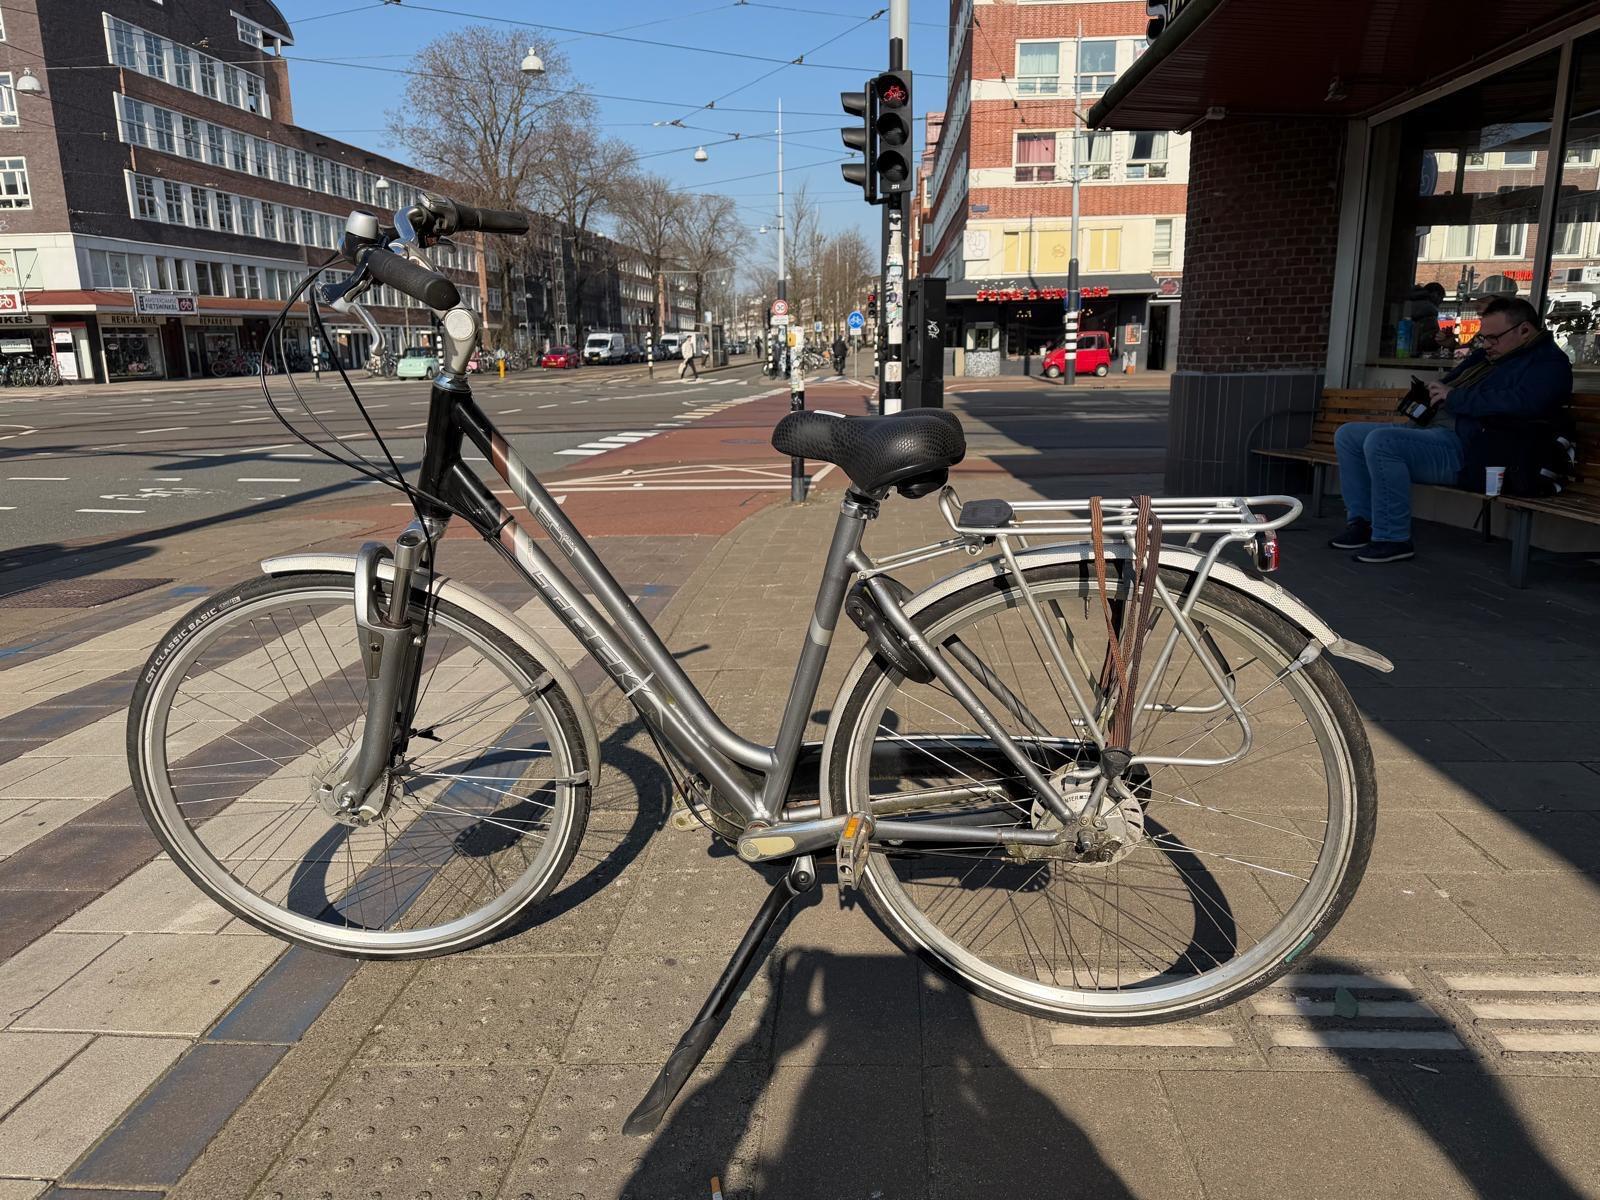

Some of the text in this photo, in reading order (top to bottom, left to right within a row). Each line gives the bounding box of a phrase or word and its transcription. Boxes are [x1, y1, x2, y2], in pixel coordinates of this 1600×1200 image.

[145, 607, 218, 684] CST CLASSIC BASIC
[531, 569, 653, 693] TREK
